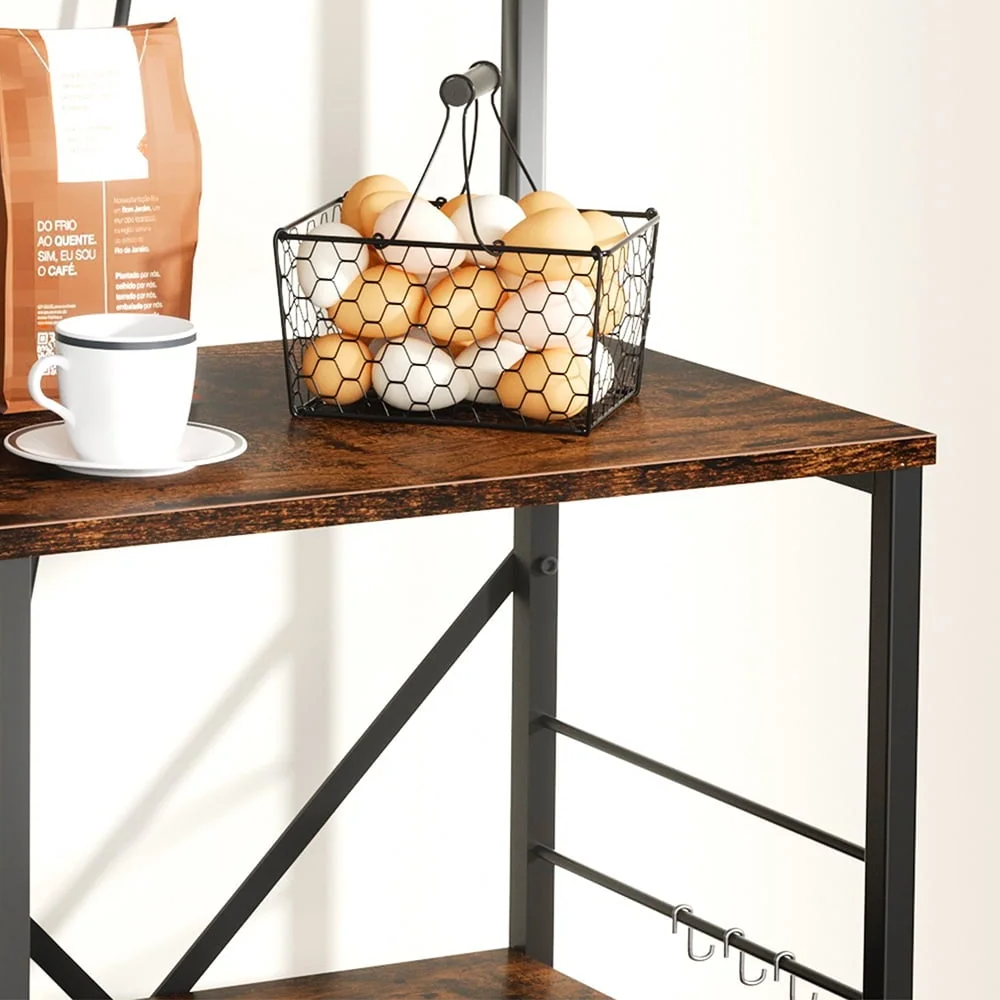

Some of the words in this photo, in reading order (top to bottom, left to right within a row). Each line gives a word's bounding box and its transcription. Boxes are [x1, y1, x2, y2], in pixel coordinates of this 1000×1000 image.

[36, 220, 52, 232] DO
[54, 219, 77, 231] FRIO
[37, 236, 52, 247] AO
[37, 250, 58, 262] SIM,
[60, 250, 73, 261] EU
[75, 249, 96, 260] SOU
[37, 266, 46, 276] O
